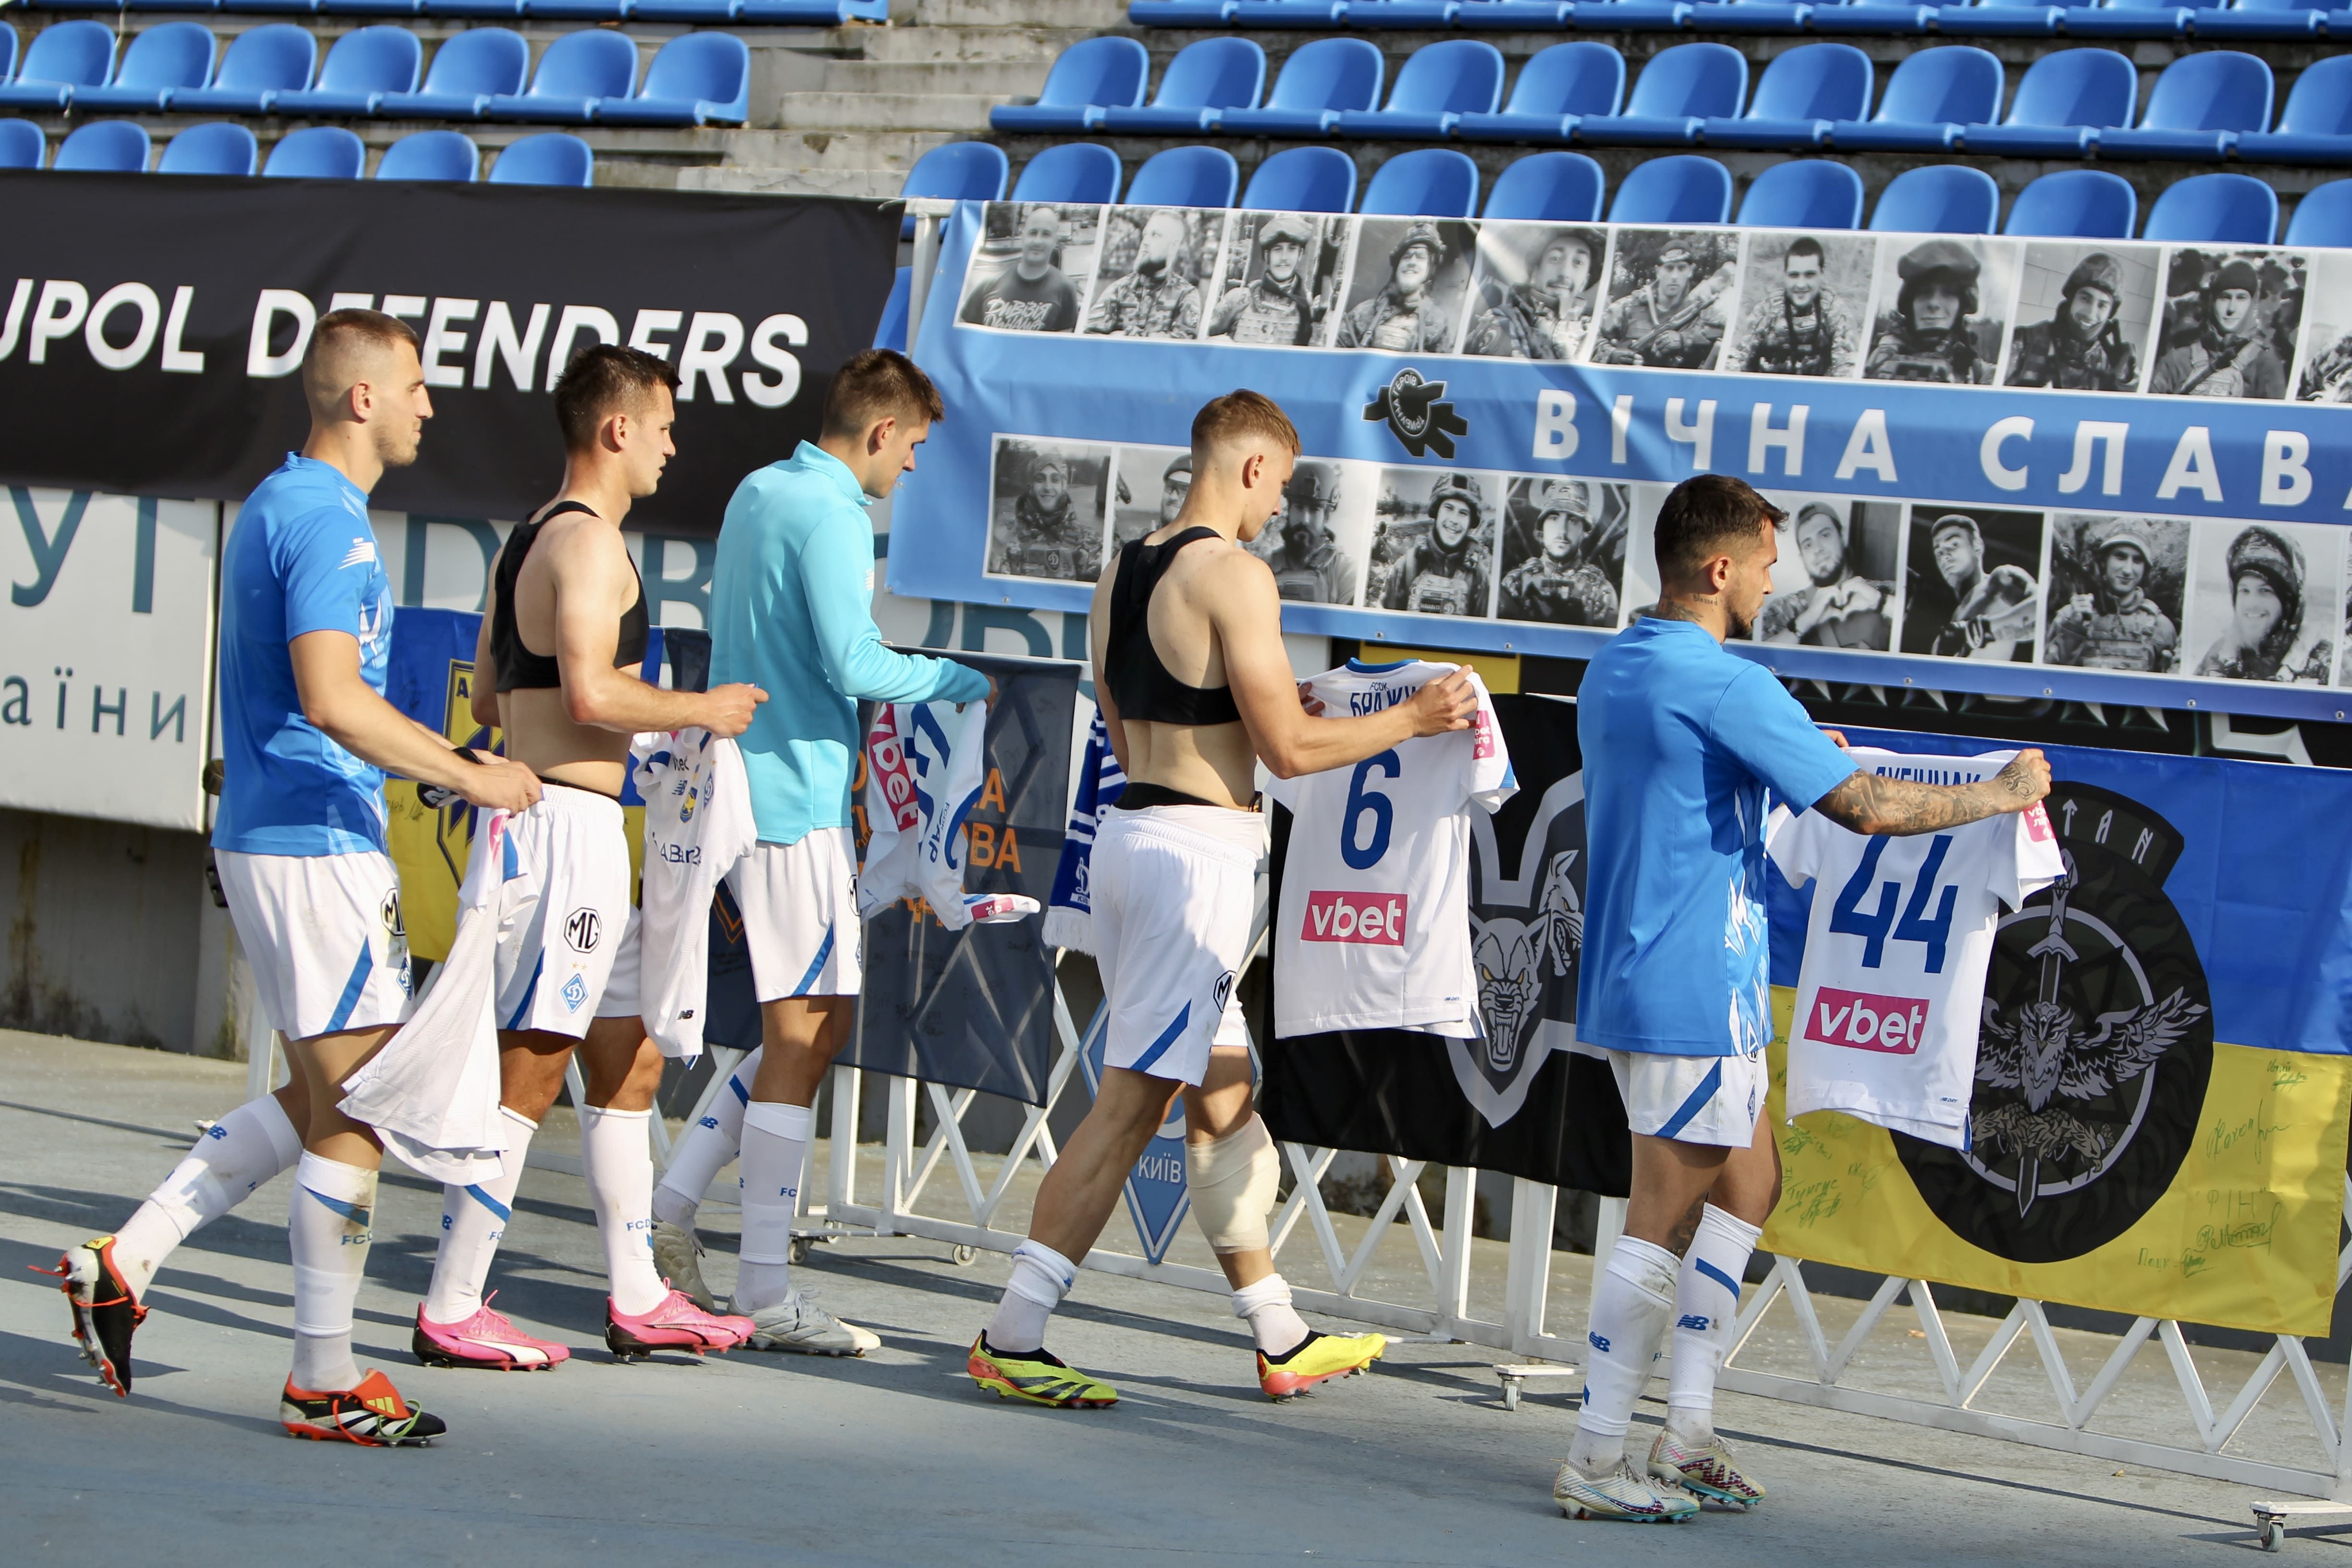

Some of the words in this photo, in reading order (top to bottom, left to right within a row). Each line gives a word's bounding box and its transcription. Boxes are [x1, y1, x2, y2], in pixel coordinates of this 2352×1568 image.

[1532, 388, 1898, 483] ВІЧНА
[1980, 416, 2352, 510] СЛАВ
[1370, 682, 1388, 692] FCDK
[1341, 748, 1401, 870] 6
[1311, 896, 1403, 940] vbet
[1829, 833, 1958, 974] 44
[568, 912, 599, 949] MG
[1819, 999, 1923, 1049] vbet
[1138, 1152, 1181, 1183] КИЇВ
